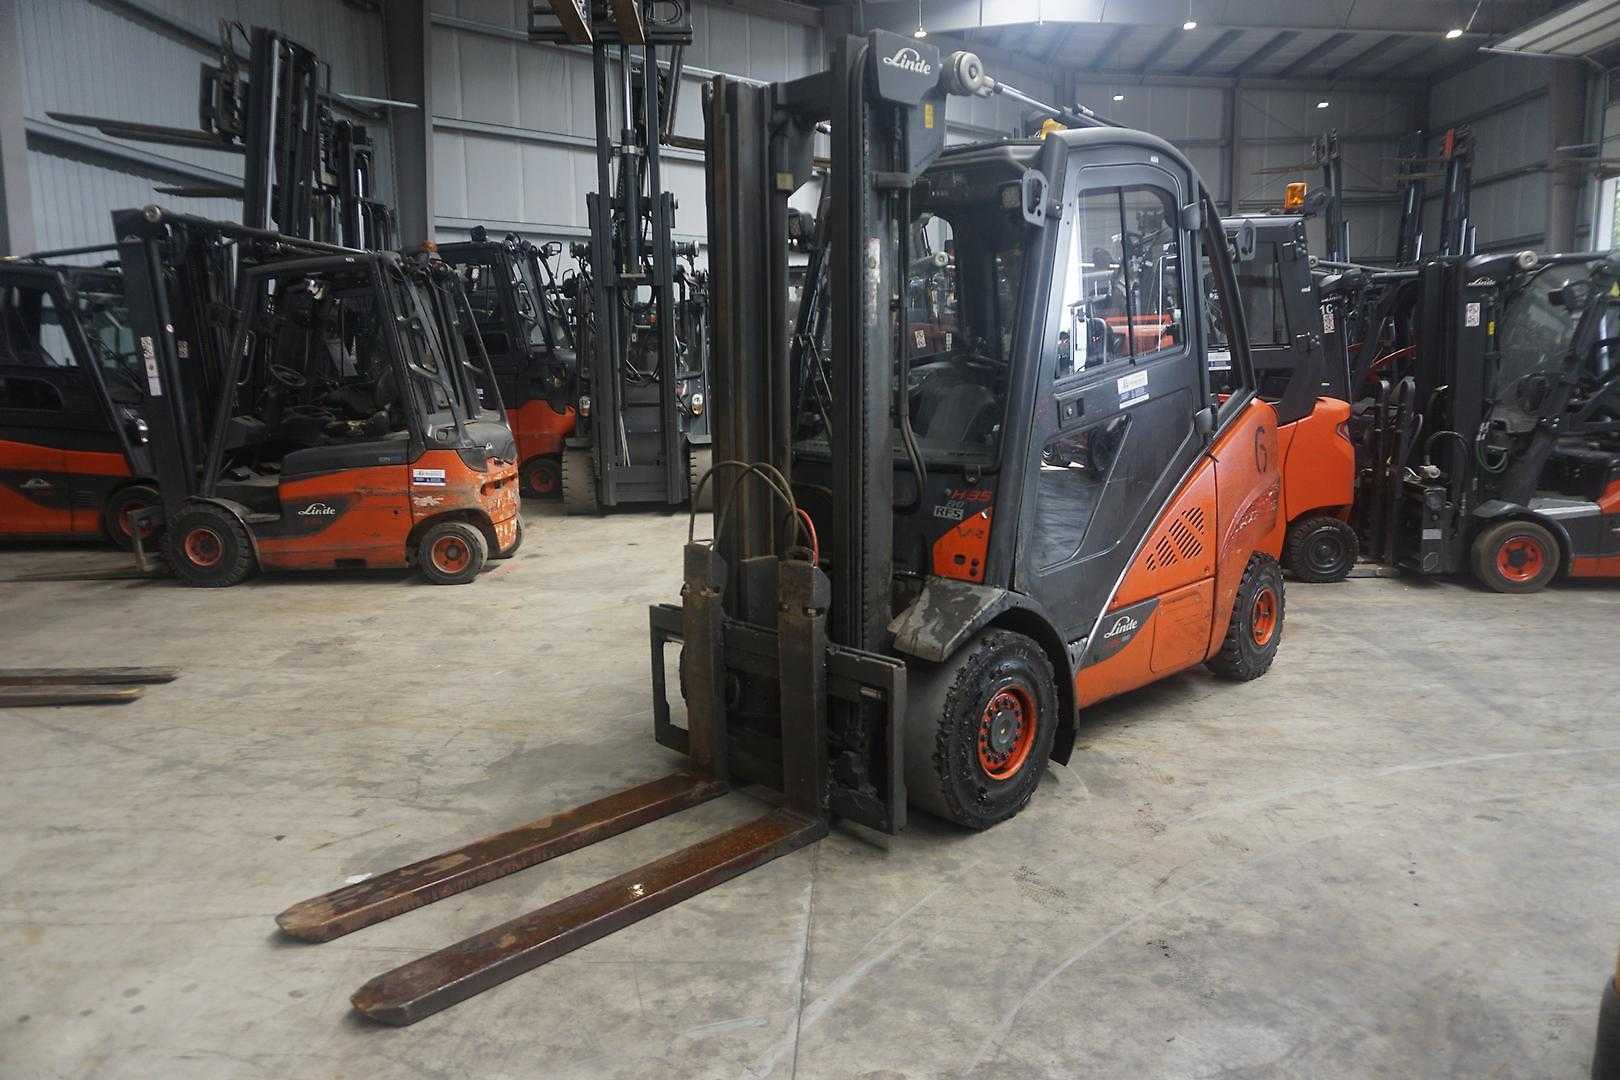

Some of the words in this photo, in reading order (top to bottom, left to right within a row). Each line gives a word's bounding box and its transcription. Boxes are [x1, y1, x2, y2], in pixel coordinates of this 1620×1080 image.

[883, 48, 931, 74] Linde
[297, 502, 336, 516] Linde
[1103, 615, 1138, 638] Linde
